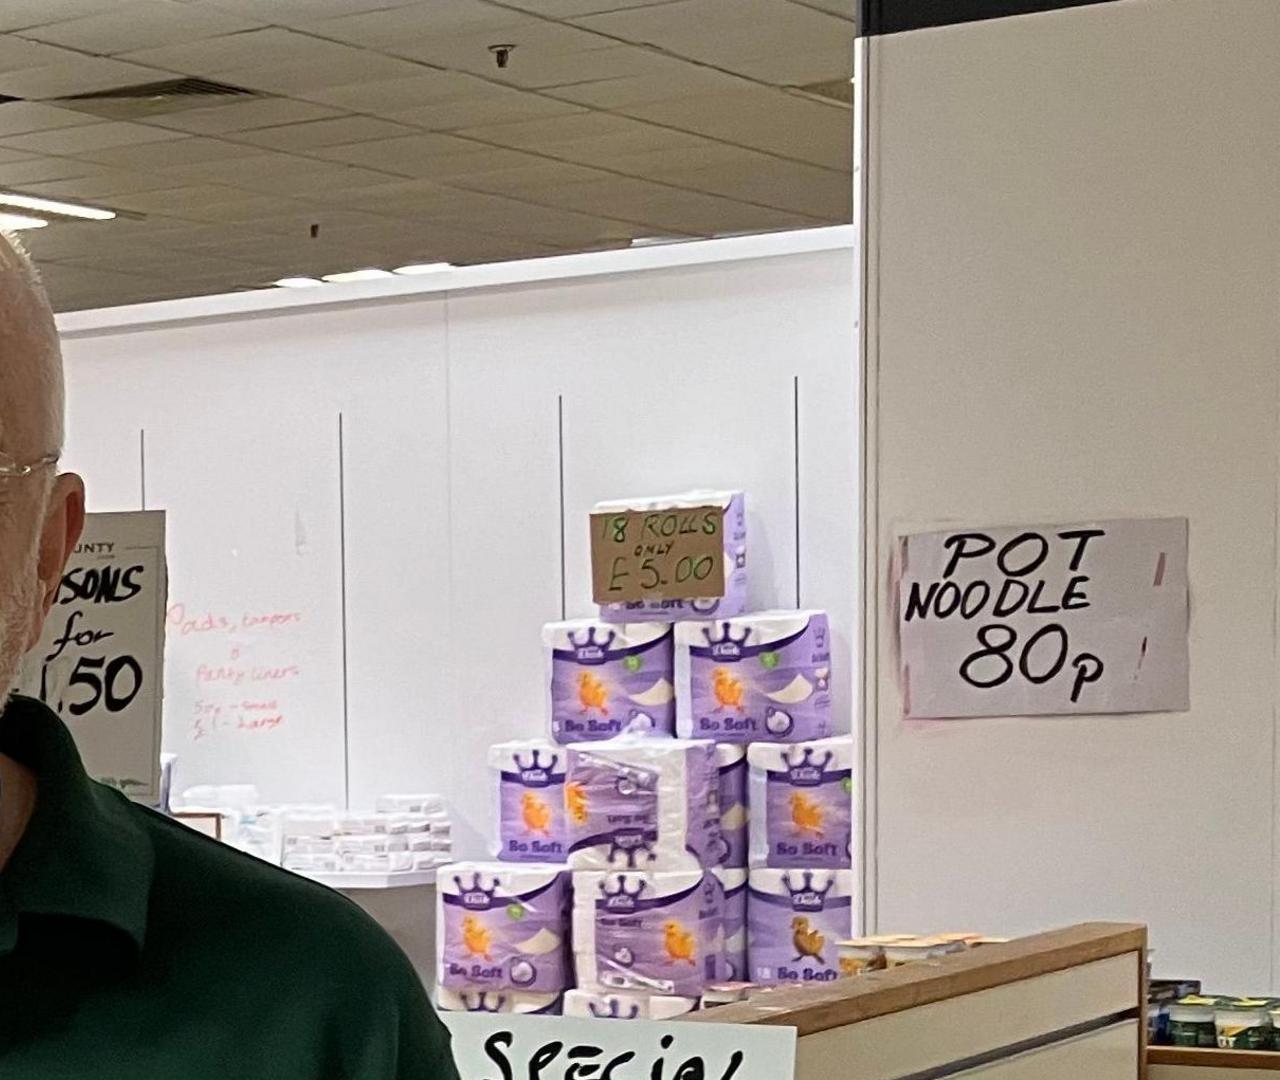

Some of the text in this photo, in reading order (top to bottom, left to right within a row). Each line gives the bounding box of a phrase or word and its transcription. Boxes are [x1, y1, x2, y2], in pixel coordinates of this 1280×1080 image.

[640, 511, 718, 540] ROLLS
[942, 529, 1106, 579] POT
[904, 576, 1091, 622] NOODLE
[45, 610, 114, 662] for
[959, 623, 1104, 704] 80p
